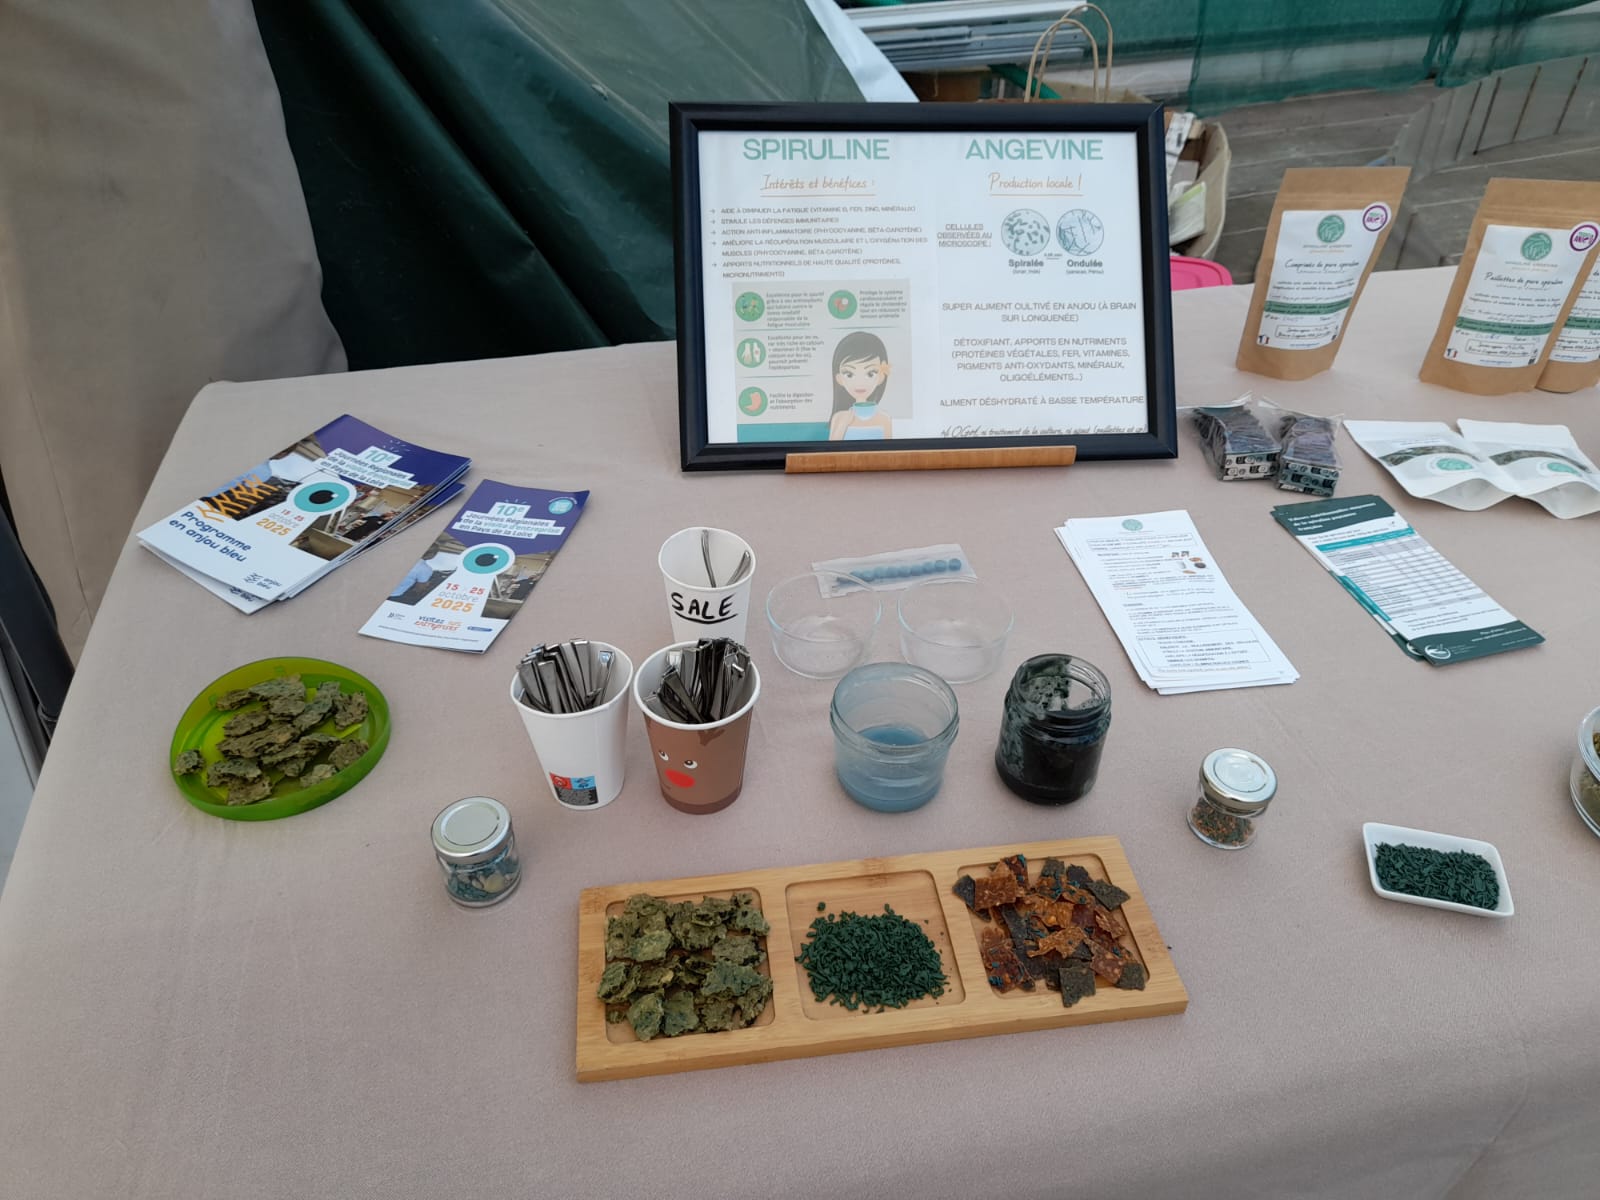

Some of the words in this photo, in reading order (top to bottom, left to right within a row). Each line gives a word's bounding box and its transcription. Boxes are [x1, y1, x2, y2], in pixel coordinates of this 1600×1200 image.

[743, 138, 890, 160] SPIRULINE
[965, 138, 1104, 160] ANGEVINE
[761, 174, 805, 190] Intérêts
[809, 177, 819, 188] et
[822, 174, 867, 191] bénéfices
[989, 172, 1043, 190] Production
[1046, 175, 1073, 188] locale
[936, 231, 980, 239] OBSERVÉES
[1008, 259, 1044, 268] Spiralée
[1066, 259, 1103, 267] Ondulée
[942, 303, 972, 311] SUPER
[974, 303, 1012, 311] ALIMENT
[1014, 302, 1050, 310] CULTIVÉ
[1067, 302, 1096, 310] ANJOU
[1097, 301, 1108, 311] (À
[1110, 302, 1136, 310] BRAIN
[1001, 314, 1020, 322] SUR
[1022, 313, 1079, 322] LONGUENÉE)
[953, 337, 1012, 347] DÉTOXIFIANT,
[1014, 338, 1056, 346] APPORTS
[1072, 338, 1127, 346] NUTRIMENTS
[952, 348, 1005, 359] (PROTÉINES
[1006, 348, 1060, 358] VÉGÉTALES,
[1062, 350, 1081, 358] FER,
[1082, 349, 1130, 358] VITAMINES,
[957, 362, 1002, 370] PIGMENTS
[1078, 360, 1124, 369] MINÉRAUX,
[940, 398, 978, 407] ALIMENT
[980, 396, 1037, 406] DÉSHYDRATÉ
[1040, 396, 1047, 405] À
[1050, 396, 1077, 405] BASSE
[1080, 394, 1144, 404] TEMPÉRATURE
[334, 452, 369, 467] Journées
[331, 464, 349, 474] Pays
[366, 477, 385, 486] Loire
[256, 518, 292, 536] 2025
[466, 513, 505, 522] Journées
[506, 517, 549, 527] Régionales
[180, 511, 252, 552] Programme
[472, 525, 491, 533] Pays
[513, 530, 533, 538] Loire
[169, 519, 186, 531] en
[186, 527, 220, 549] anjou
[220, 546, 247, 562] bleu
[446, 582, 460, 591] 15
[469, 586, 485, 596] 25
[439, 591, 479, 603] octobre
[432, 597, 474, 613] 2025
[670, 591, 736, 620] SALE
